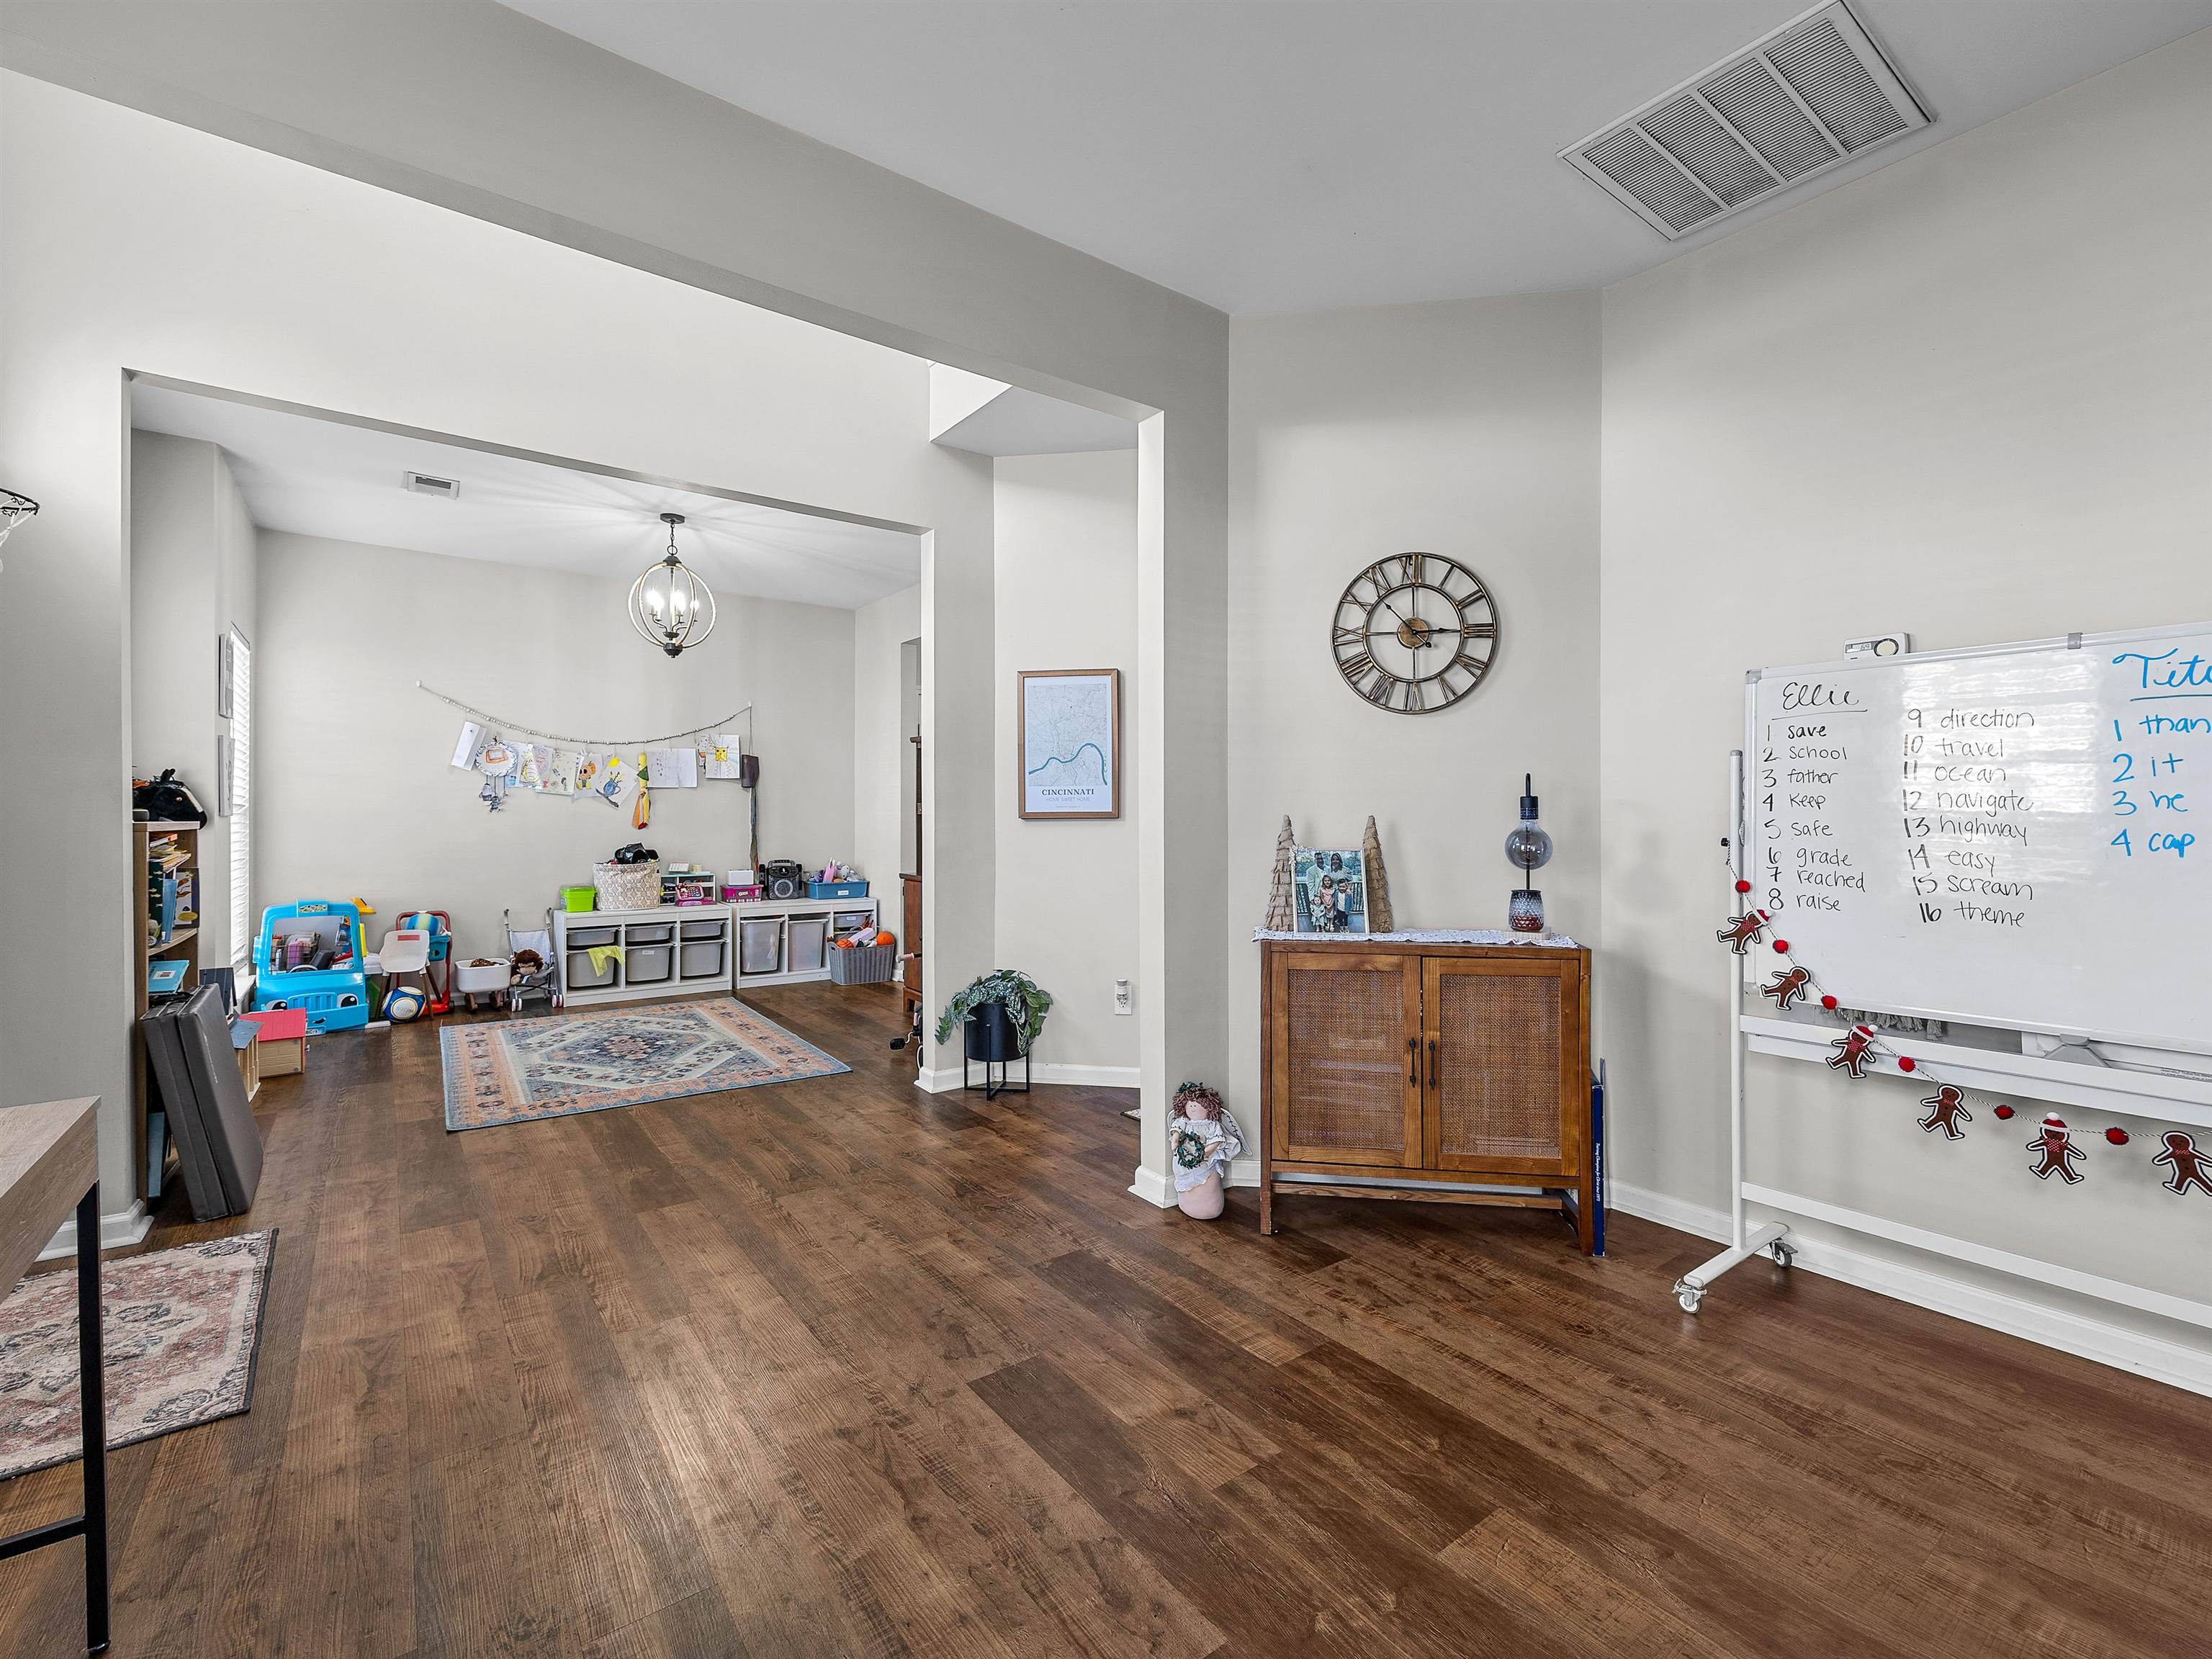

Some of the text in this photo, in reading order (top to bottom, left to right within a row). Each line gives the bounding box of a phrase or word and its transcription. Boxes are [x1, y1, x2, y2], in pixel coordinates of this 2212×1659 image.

[1783, 682, 1859, 711] Ellie
[1907, 708, 2034, 729] 9 direction
[2114, 714, 2212, 742] 1 than
[1767, 724, 1827, 742] 1 save
[1904, 734, 2004, 757] 10 travel
[1763, 747, 1781, 763] 2
[2112, 752, 2184, 783] 2 it
[1761, 768, 1838, 788] 3 father
[1904, 760, 2006, 783] 11 ocean
[1762, 793, 1774, 811] 4
[1902, 788, 2034, 818] 12 navigate
[2112, 791, 2138, 816] 3
[1764, 819, 1833, 840] 5 safe
[1904, 814, 2028, 847] 13 highway
[2110, 828, 2195, 858] 4 cap
[1768, 847, 1853, 868] 6 grade
[1907, 844, 1995, 878] 14 easy
[1766, 866, 1866, 893] 7 reached
[1912, 872, 2033, 901] 15 scream
[1768, 888, 1841, 912] 8 raise
[1919, 901, 2025, 928] 16 theme
